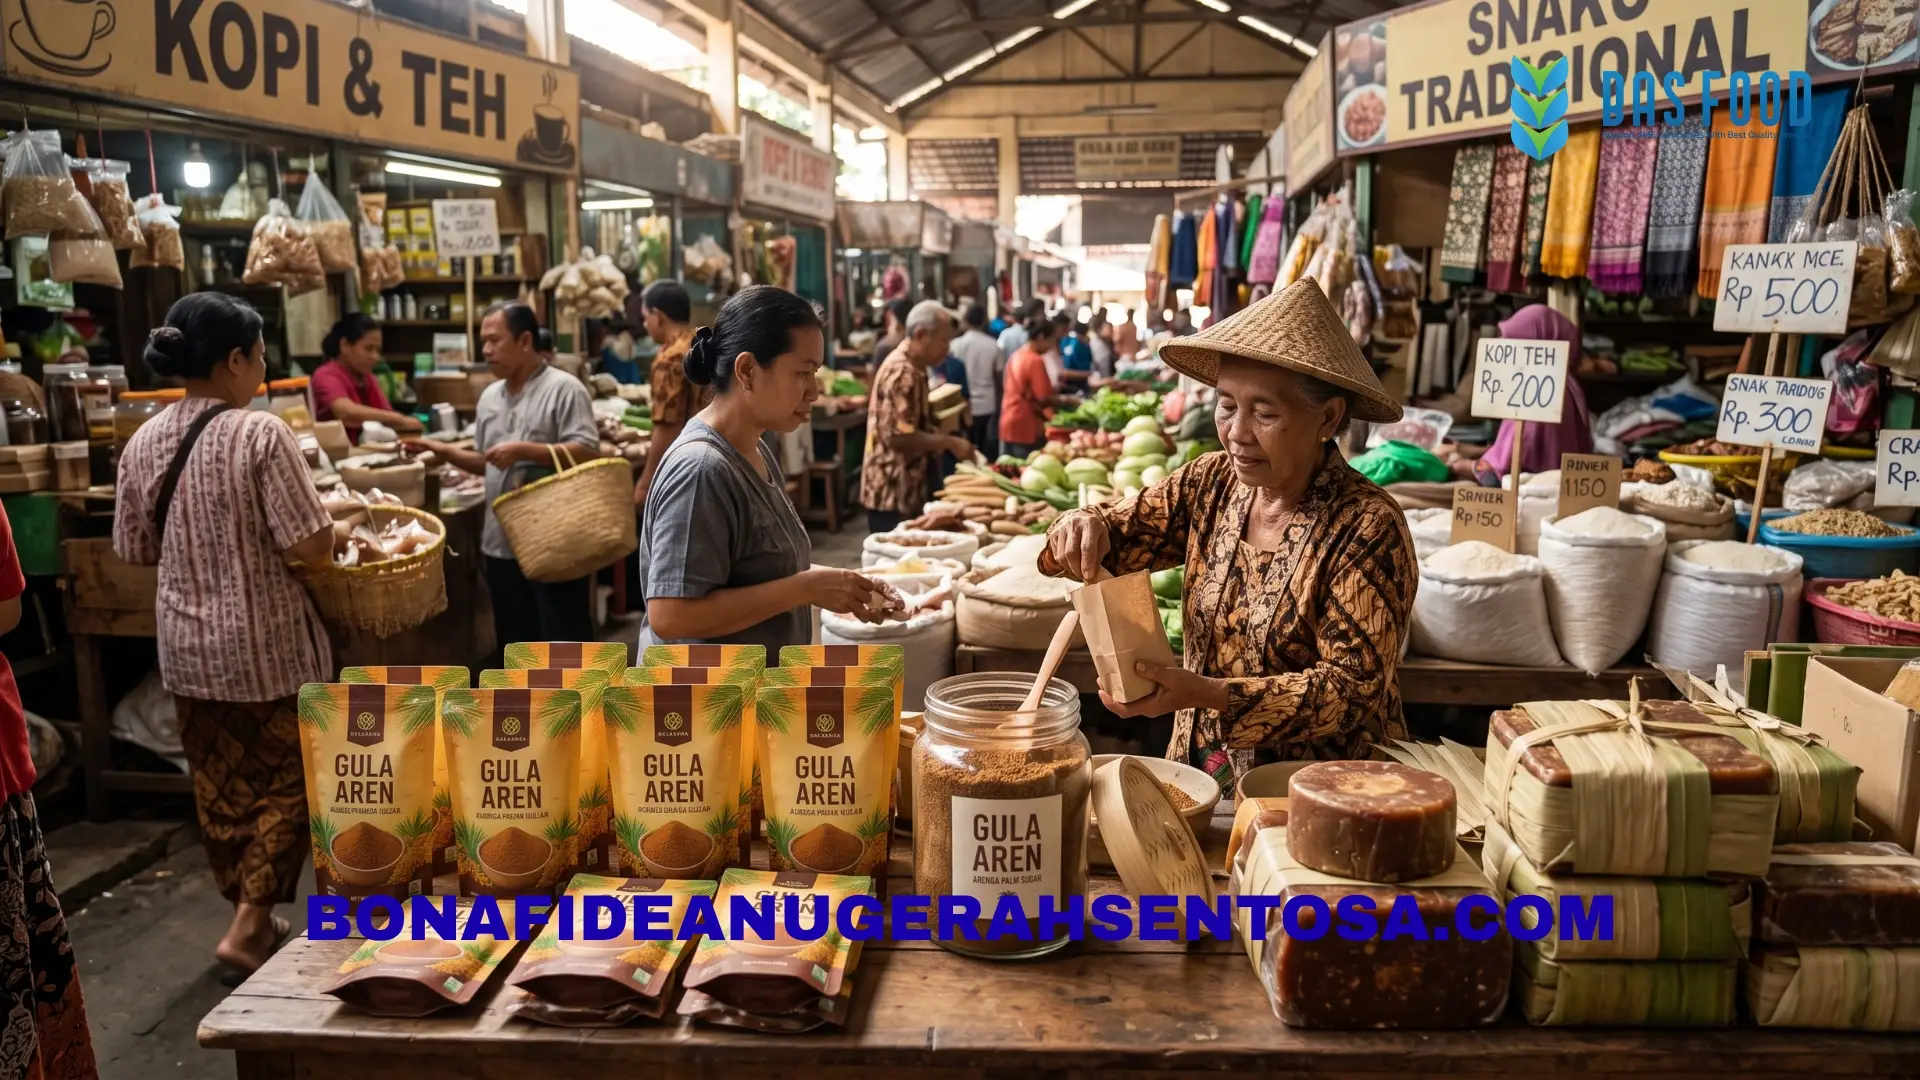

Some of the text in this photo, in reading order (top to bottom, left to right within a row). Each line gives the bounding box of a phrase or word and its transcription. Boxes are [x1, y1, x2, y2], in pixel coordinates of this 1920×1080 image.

[154, 0, 505, 141] KOPI & TEH
[1723, 276, 1752, 313] Rp
[1484, 343, 1556, 366] KOPI TEH
[1480, 369, 1555, 408] Rp. 200
[1728, 377, 1768, 395] SNAK
[1722, 399, 1812, 435] Rp. 300
[1455, 507, 1473, 527] Rp
[334, 753, 394, 778] GULA
[480, 758, 542, 783] GULA
[643, 753, 704, 778] GULA
[795, 755, 856, 779] GULA
[334, 780, 394, 805] AREN
[481, 785, 542, 809] AREN
[644, 779, 704, 803] AREN
[796, 782, 856, 806] AREN
[973, 813, 1042, 842] GULA
[972, 843, 1042, 873] AREN
[972, 874, 1042, 885] ARENGA PALM SUGAR
